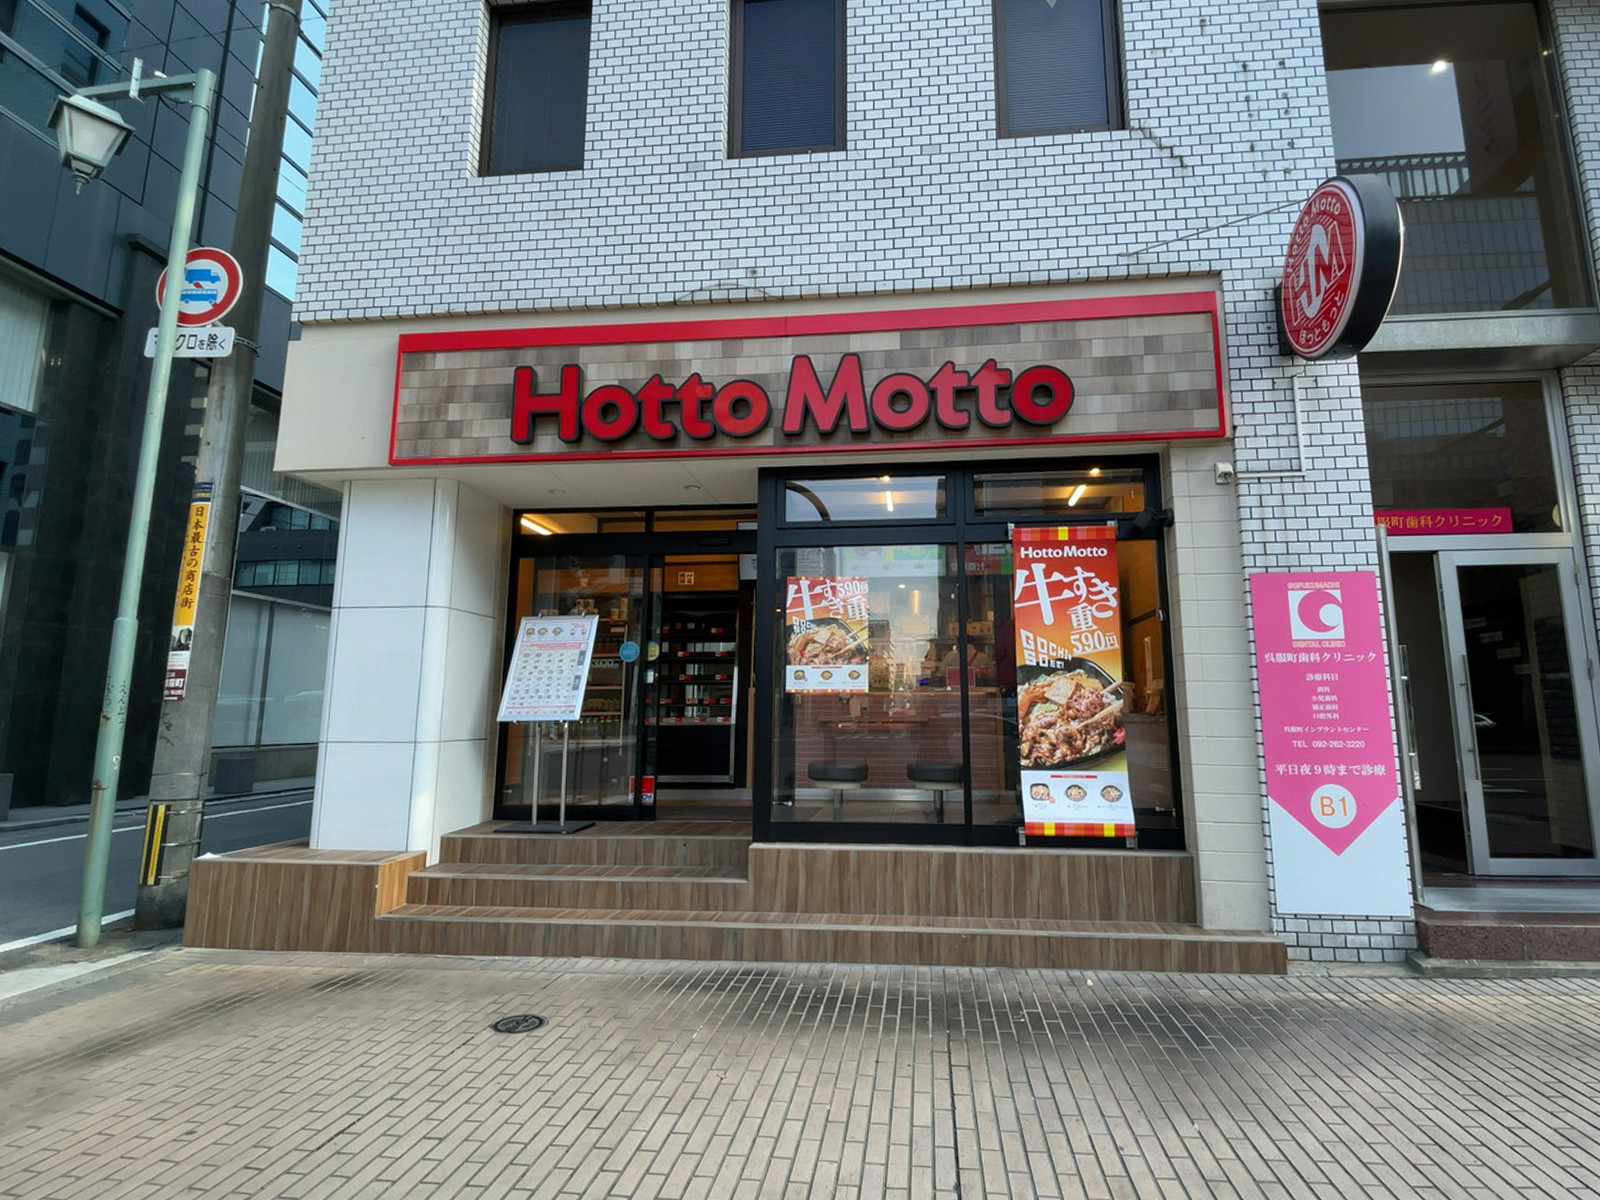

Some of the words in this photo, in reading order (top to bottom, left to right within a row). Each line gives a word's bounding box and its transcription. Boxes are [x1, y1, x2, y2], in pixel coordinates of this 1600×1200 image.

[1310, 196, 1342, 217] Motto
[1299, 290, 1345, 345] ほっともっと
[154, 332, 226, 351] クロを除く
[510, 363, 771, 444] Hotto
[781, 352, 1075, 435] Motto
[180, 506, 205, 609] 日本最古の商店街
[1070, 630, 1119, 654] 590円
[1264, 652, 1377, 663] 呉服町歯科クリニック
[1292, 740, 1308, 748] TEL
[1319, 796, 1348, 817] B1
